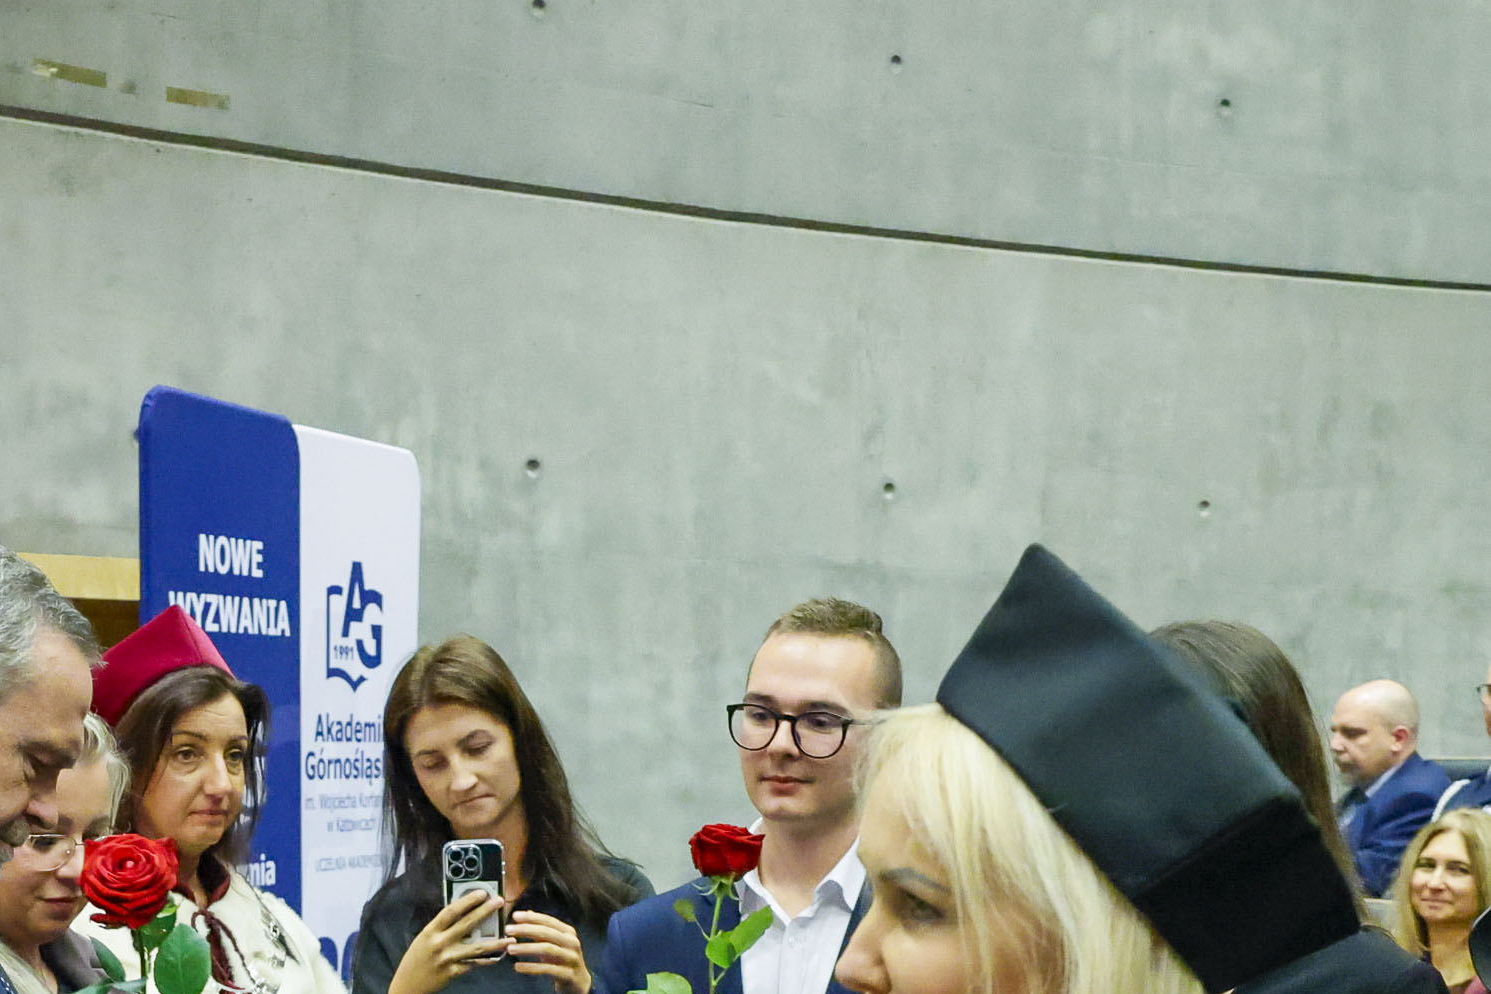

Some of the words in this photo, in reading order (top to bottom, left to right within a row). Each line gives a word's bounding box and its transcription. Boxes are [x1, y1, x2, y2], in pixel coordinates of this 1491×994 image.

[198, 533, 264, 578] NOWE
[333, 645, 354, 660] 1991
[314, 713, 384, 743] Akademi
[305, 747, 384, 786] Górnośląs
